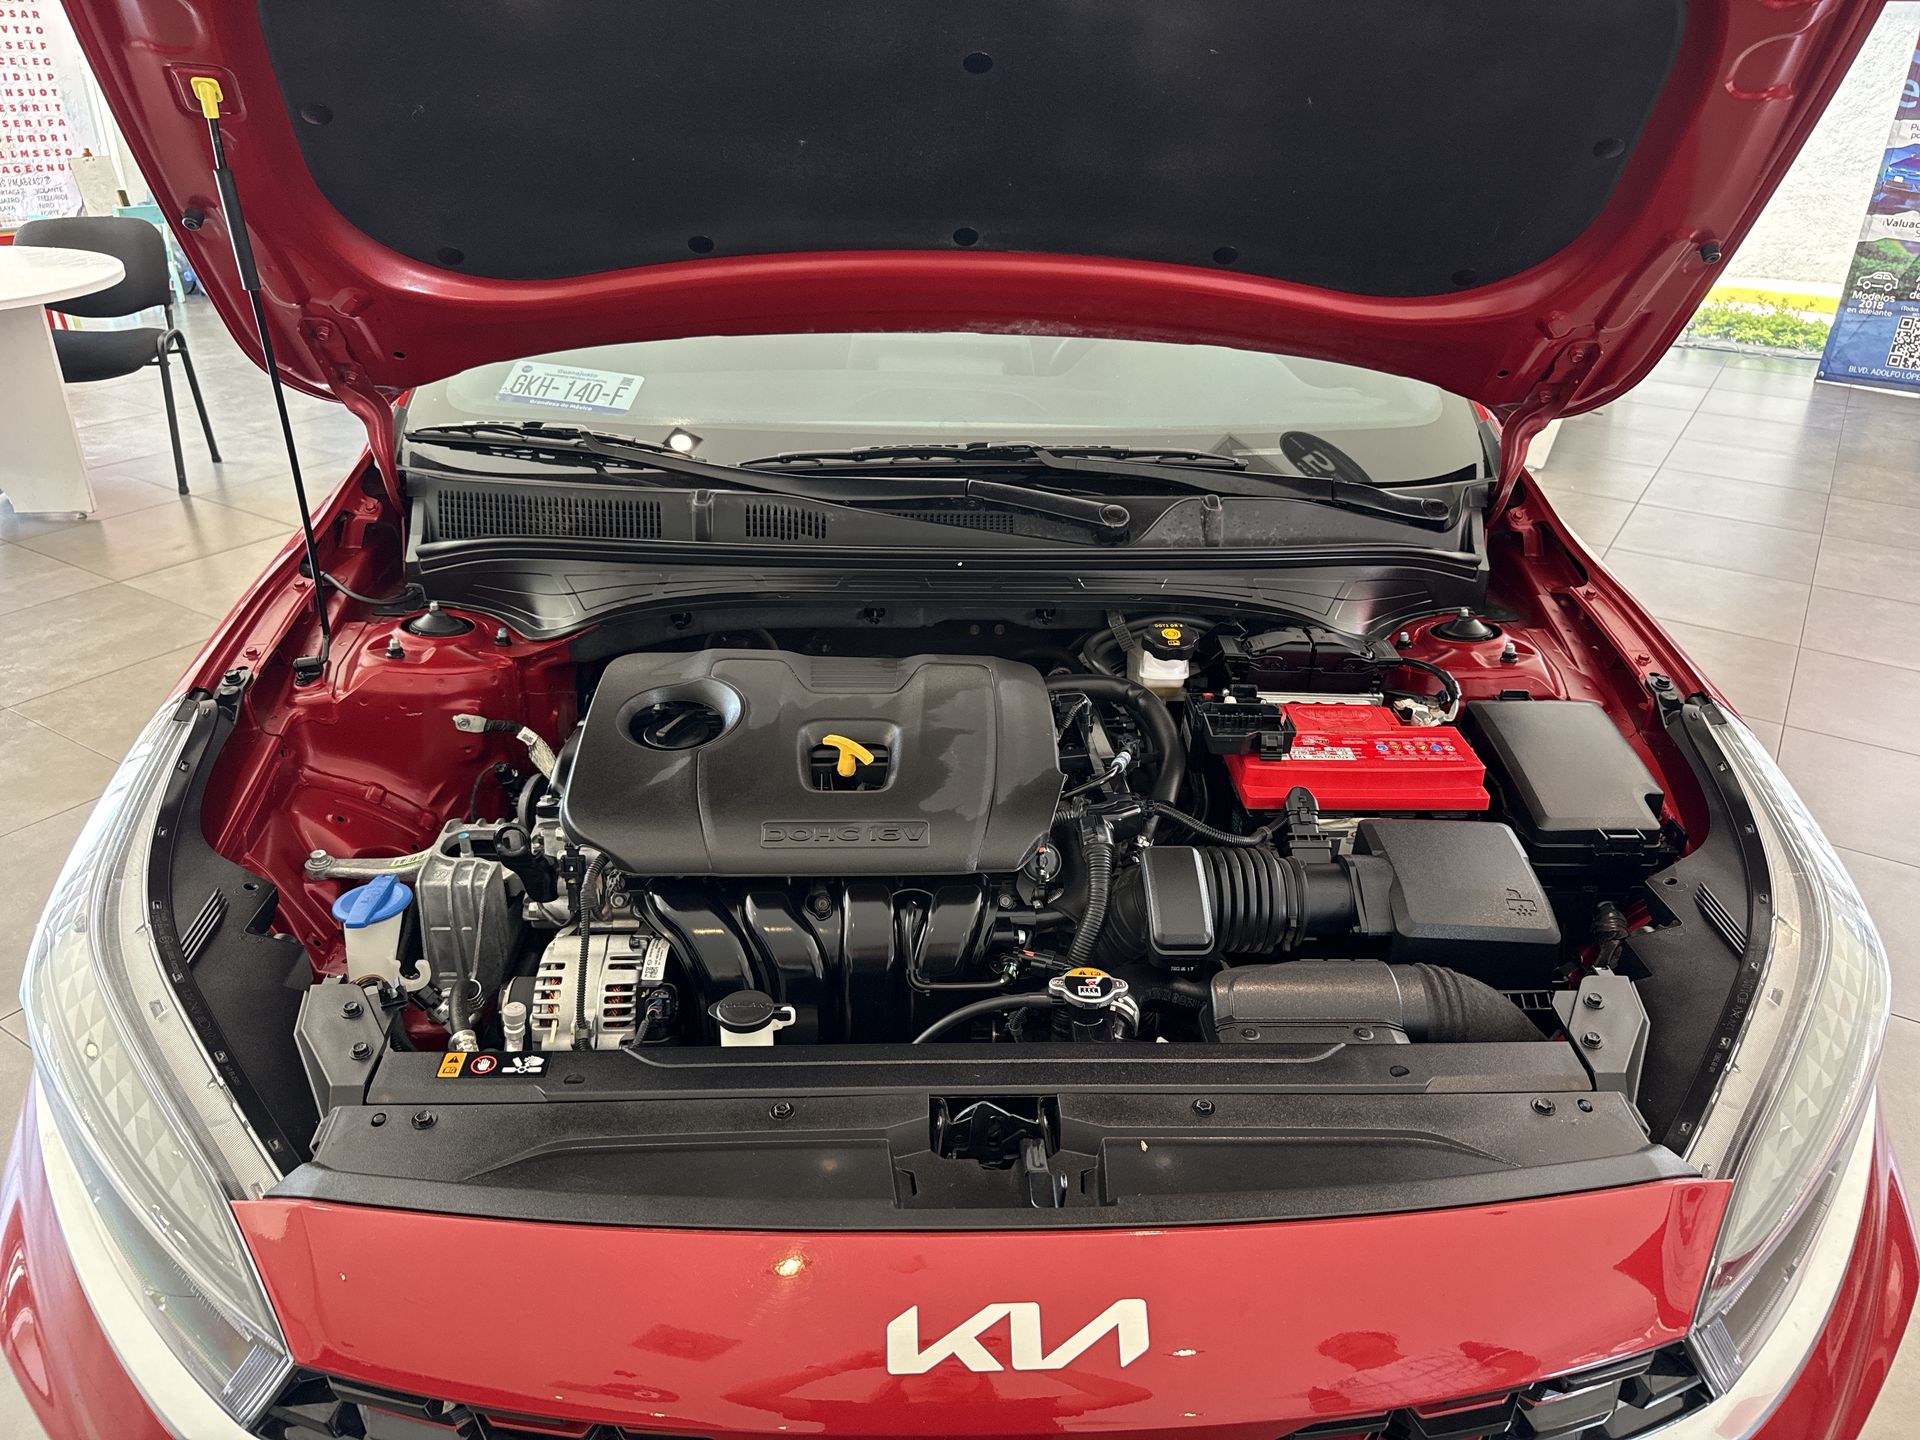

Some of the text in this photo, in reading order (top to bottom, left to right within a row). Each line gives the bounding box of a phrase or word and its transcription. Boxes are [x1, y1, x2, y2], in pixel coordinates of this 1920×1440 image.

[1852, 290, 1896, 303] Modelos
[1858, 299, 1885, 310] 2018
[1846, 306, 1893, 317] en adelante
[1848, 365, 1869, 374] BLVD.
[1870, 367, 1901, 379] ADOLFO
[763, 826, 926, 842] DOHC 16V
[886, 1298, 1150, 1375] KIA
